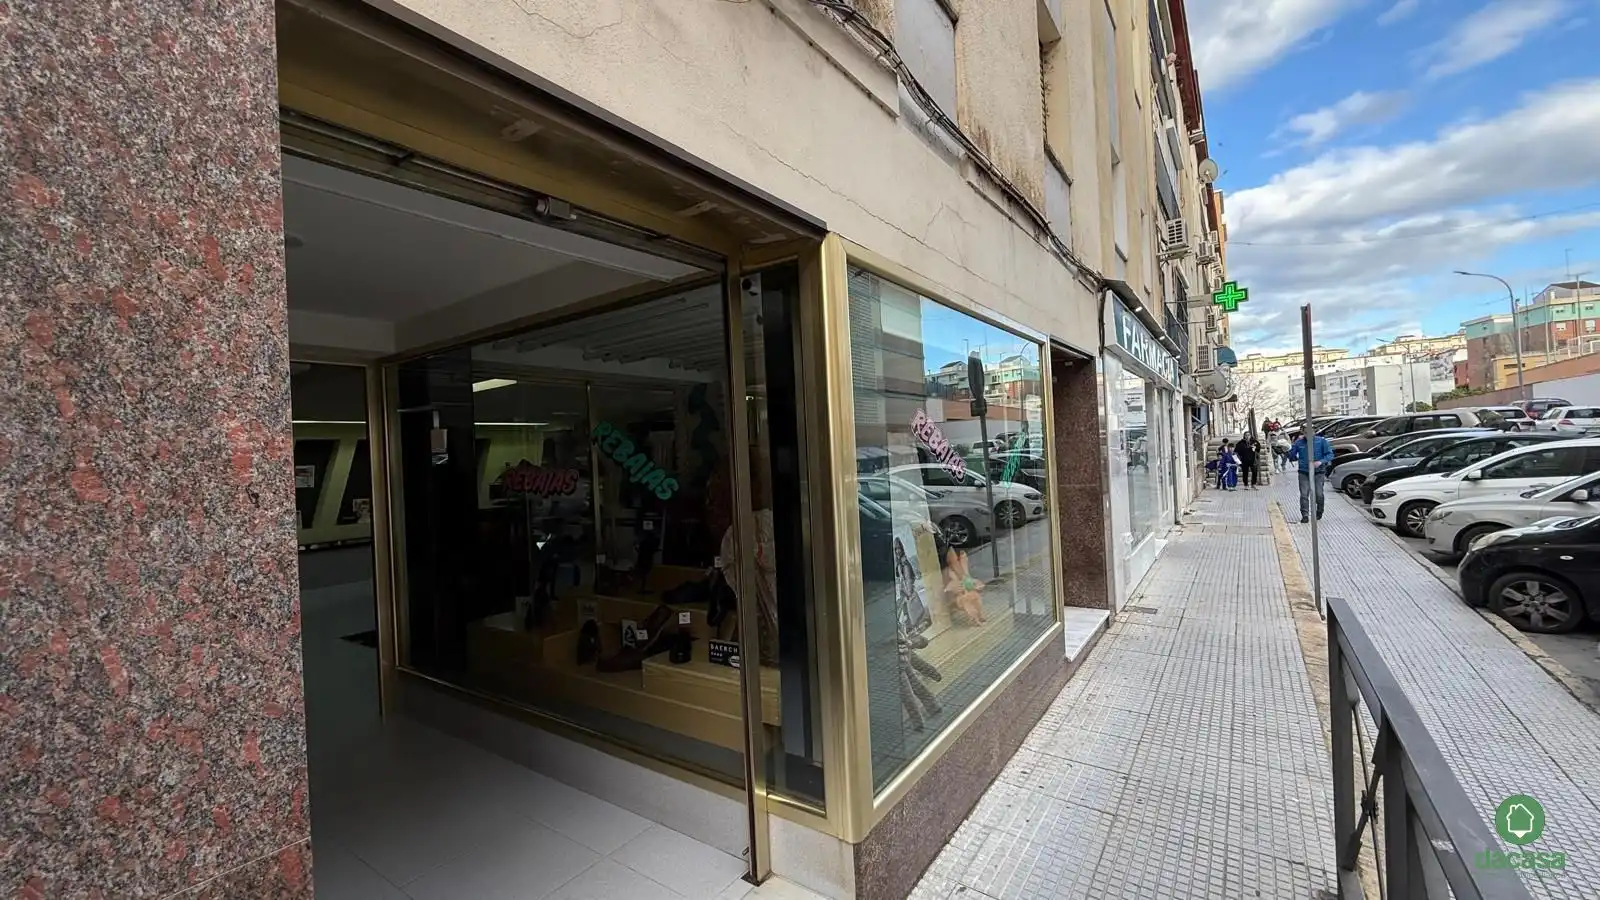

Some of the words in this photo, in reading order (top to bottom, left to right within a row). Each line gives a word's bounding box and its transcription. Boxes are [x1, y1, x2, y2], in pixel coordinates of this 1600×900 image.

[1122, 314, 1174, 383] FARMACIA
[593, 420, 679, 500] REBAJAS
[911, 409, 967, 484] REBAJAS
[504, 467, 580, 499] REBAJAS
